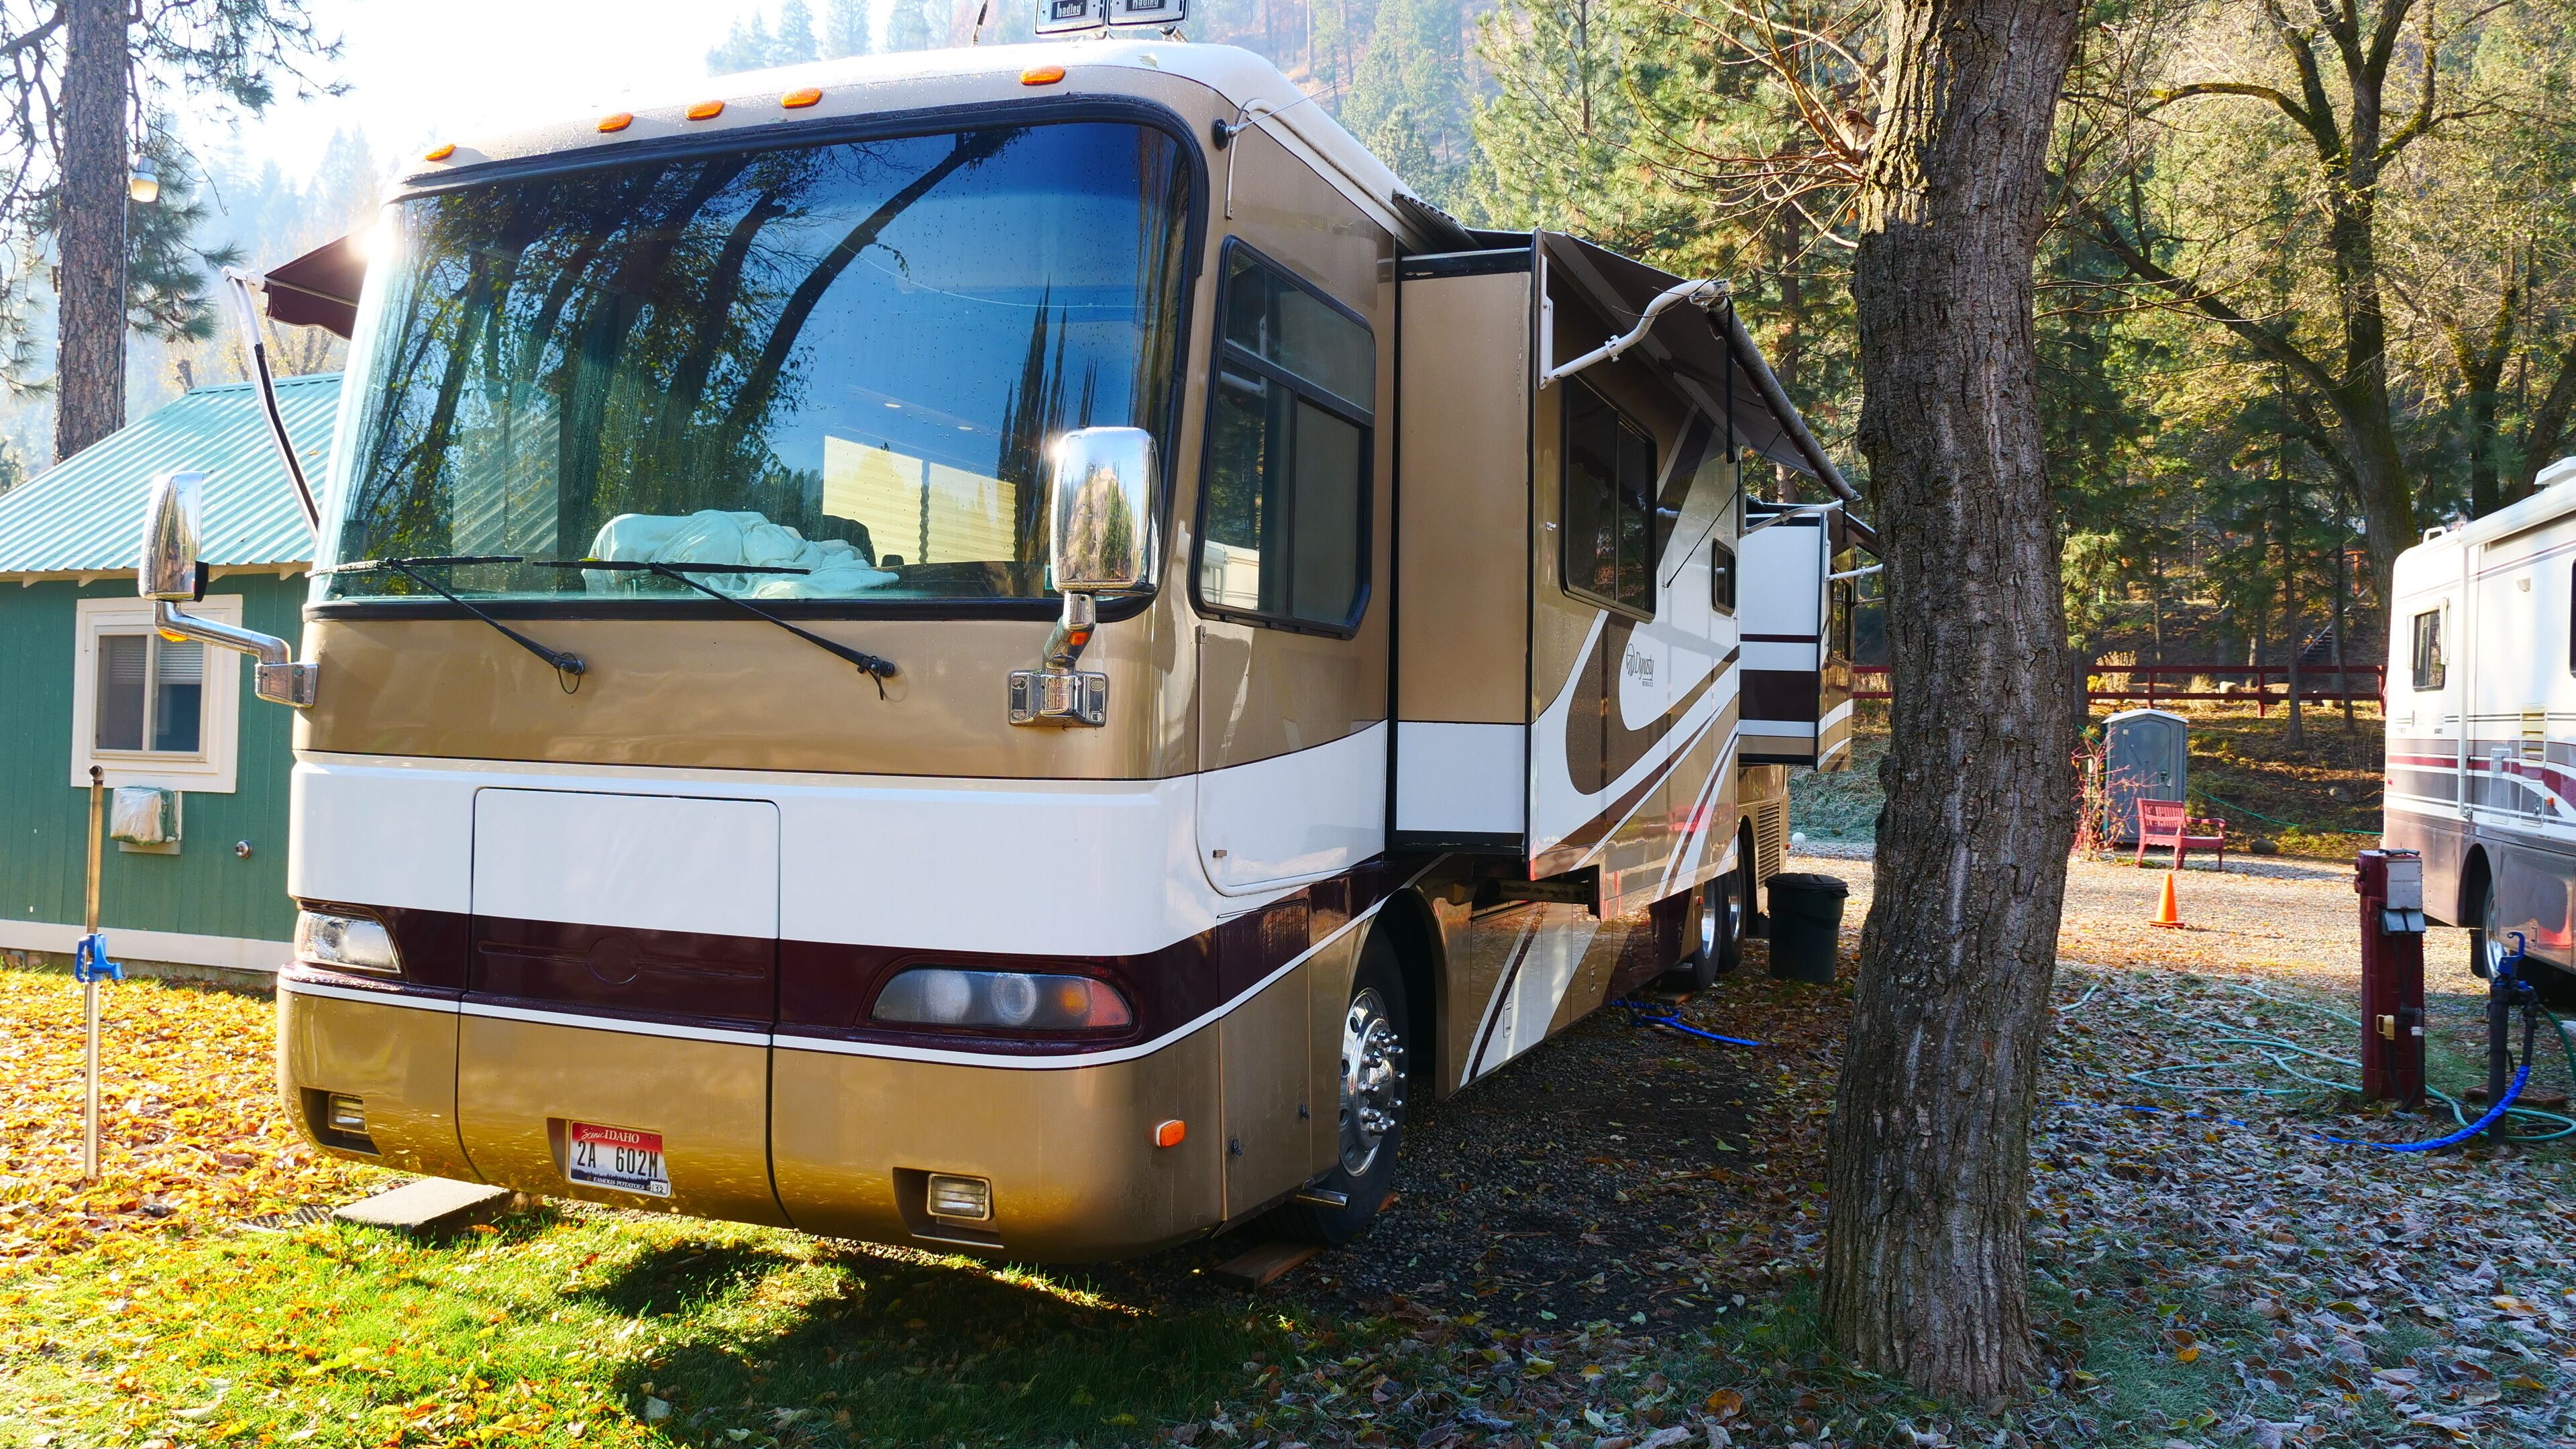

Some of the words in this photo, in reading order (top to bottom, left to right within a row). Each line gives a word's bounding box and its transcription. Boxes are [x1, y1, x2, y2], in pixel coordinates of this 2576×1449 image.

[1057, 3, 1081, 17] hadley
[582, 1128, 605, 1140] Scenic
[604, 1130, 639, 1143] IDAHO
[577, 1140, 596, 1168] 2A
[616, 1146, 658, 1178] 602M
[594, 1177, 616, 1185] FAMOUS
[616, 1180, 645, 1189] POTATOES
